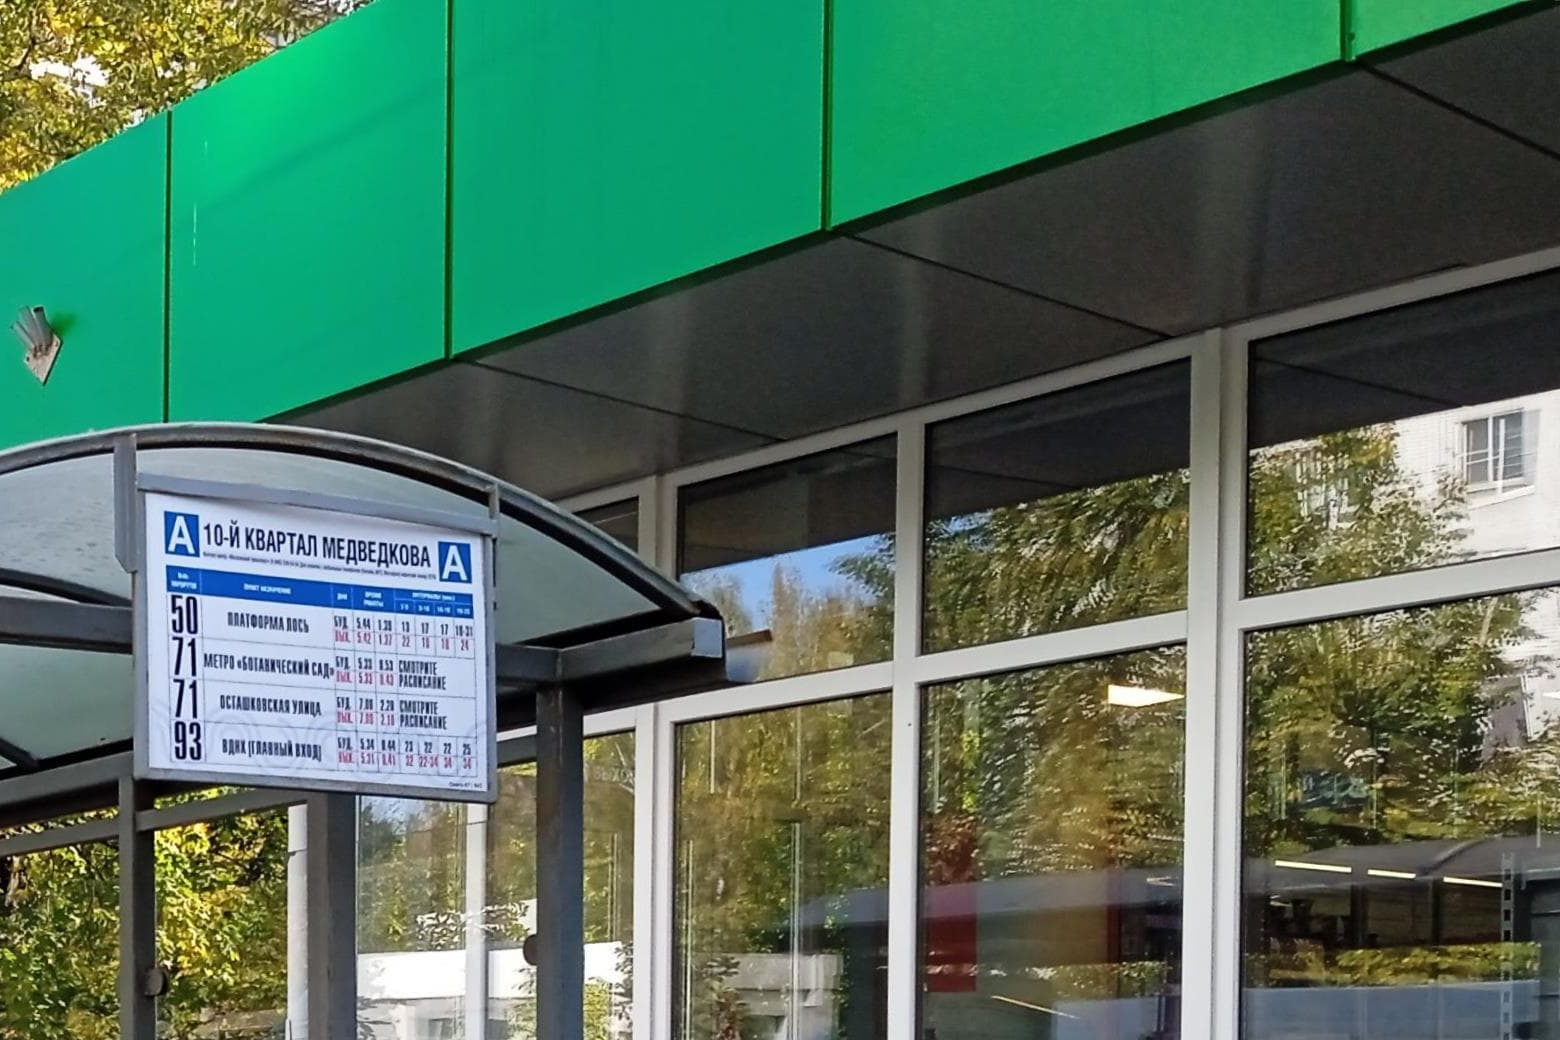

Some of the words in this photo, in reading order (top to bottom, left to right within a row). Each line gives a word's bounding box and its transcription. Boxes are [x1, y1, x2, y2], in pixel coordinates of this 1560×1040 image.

[168, 515, 196, 555] А
[203, 519, 240, 549] 10-Й
[245, 527, 318, 557] КВАРТАЛ
[322, 536, 431, 568] МЕДВЕДКОВА
[441, 545, 468, 581] А
[171, 594, 199, 635] 50
[227, 611, 285, 631] ПЛАТФОРМА
[286, 617, 309, 634] ЛОСЬ
[421, 622, 430, 634] 17
[440, 623, 449, 636] 17
[401, 636, 410, 647] 22
[172, 636, 197, 677] 71
[203, 653, 235, 670] МЕТРО
[236, 655, 310, 676] «БОТАНИЧЕСКИЙ
[311, 662, 334, 679] САД»
[399, 659, 437, 676] СМОТРИТЕ
[399, 674, 446, 690] РАСПИСАНИЕ
[173, 678, 198, 719] 71
[219, 694, 290, 714] ОСТАШКОВСКАЯ
[291, 700, 322, 718] УЛИЦА
[399, 699, 438, 715] СМОТРИТЕ
[399, 714, 447, 730] РАСПИСАНИЕ
[174, 721, 202, 761] 93
[222, 738, 246, 755] ВДНХ
[248, 739, 293, 758] (ГЛАВНЫЙ
[295, 743, 322, 762] ВХОД)
